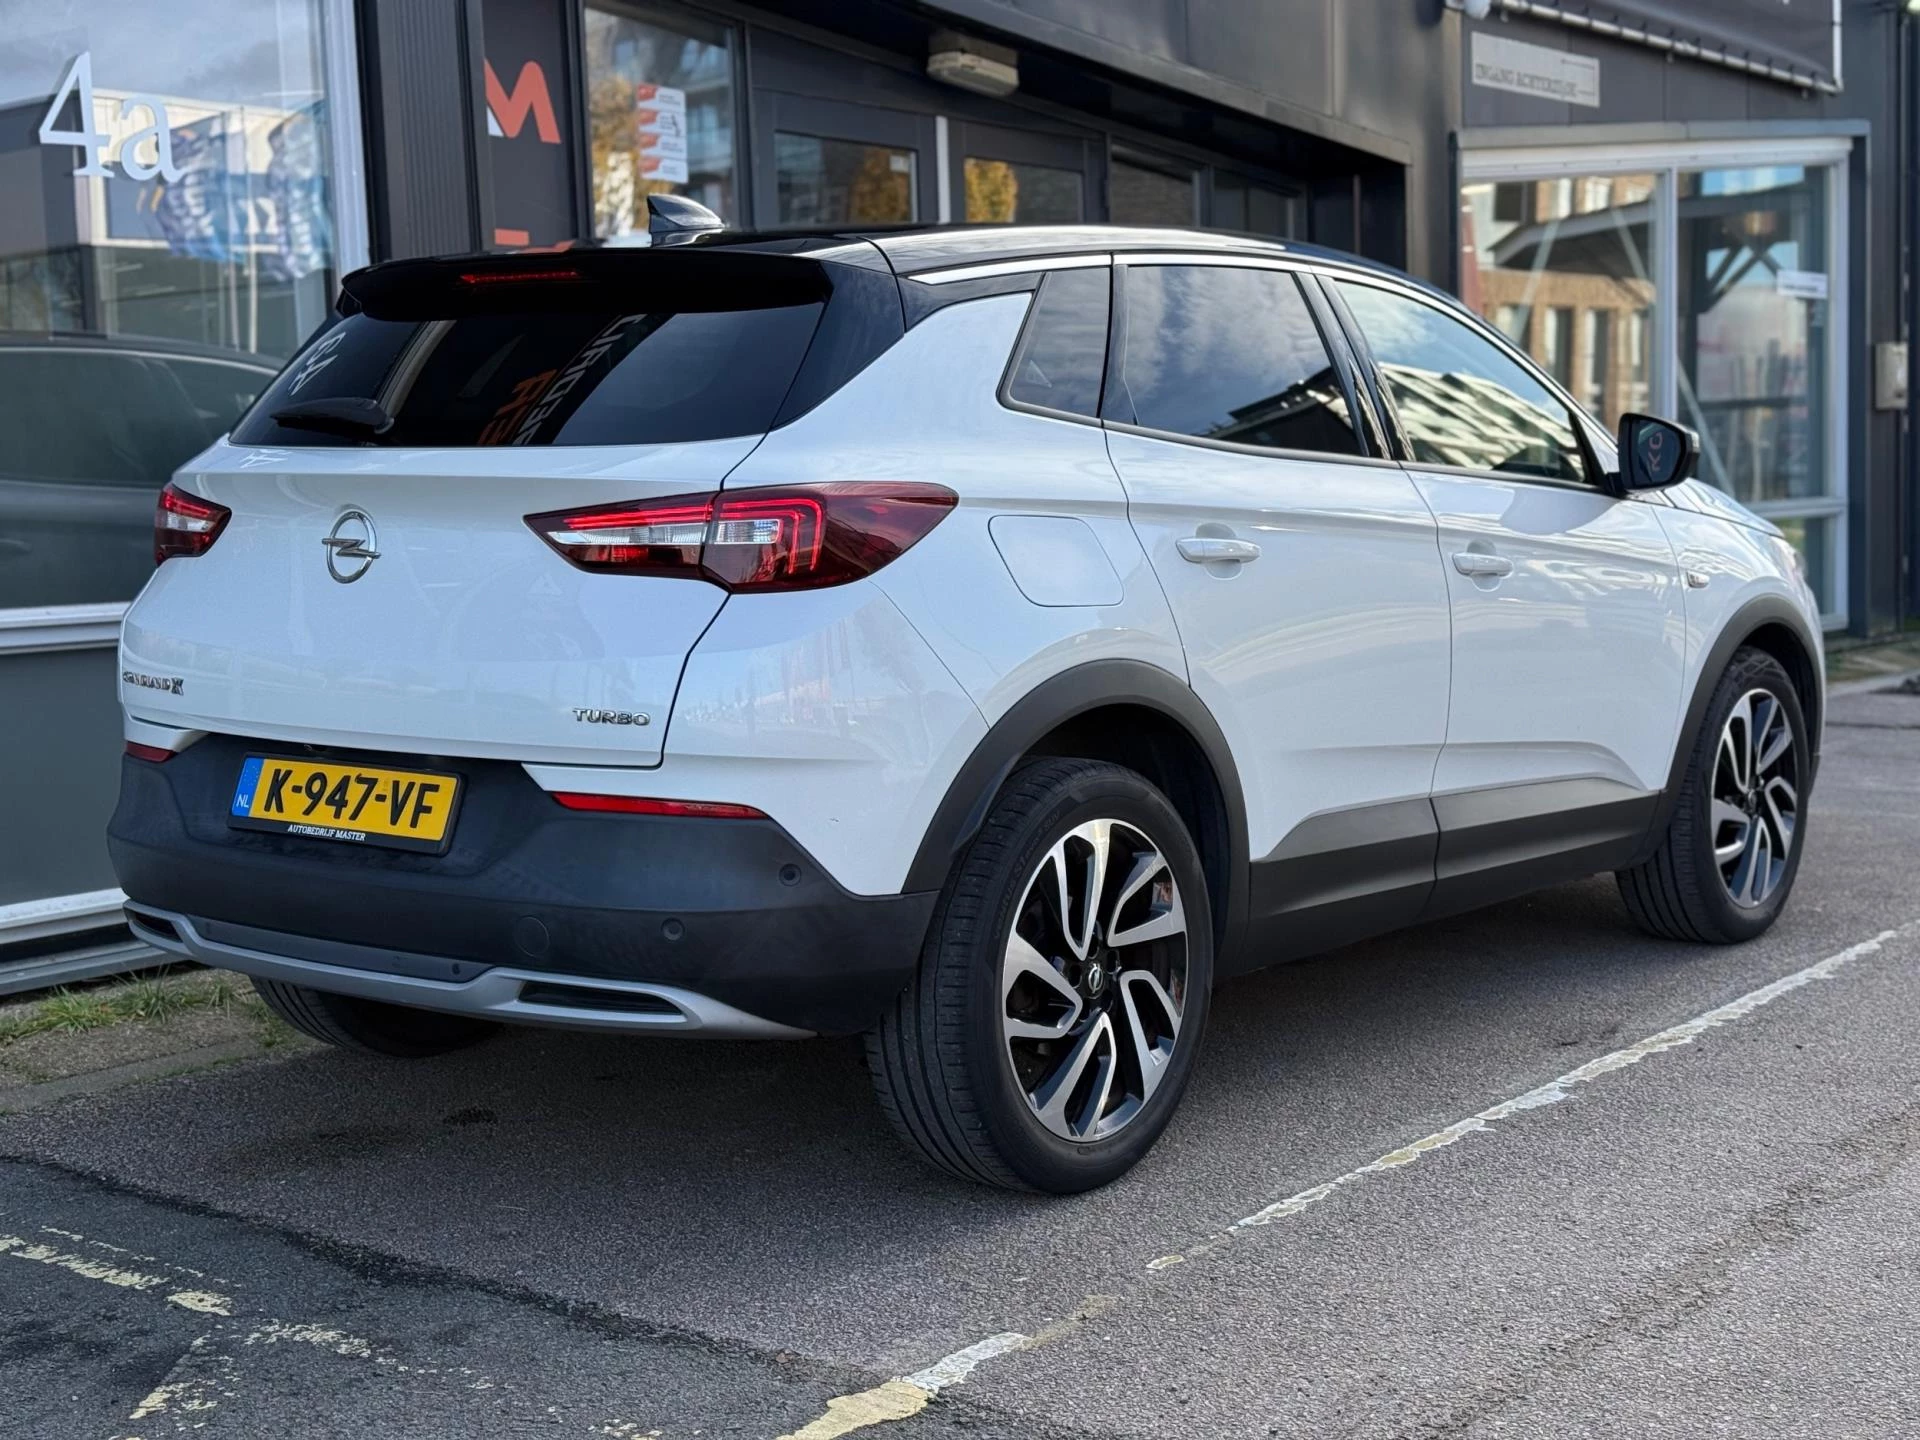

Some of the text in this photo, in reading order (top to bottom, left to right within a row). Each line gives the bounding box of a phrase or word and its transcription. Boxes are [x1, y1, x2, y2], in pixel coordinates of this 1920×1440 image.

[38, 51, 188, 182] 4a
[572, 707, 651, 726] TURBO
[235, 793, 250, 809] NL
[263, 768, 440, 829] K-947-VF
[287, 823, 366, 842] AUTOBEDRIJF MASTER
